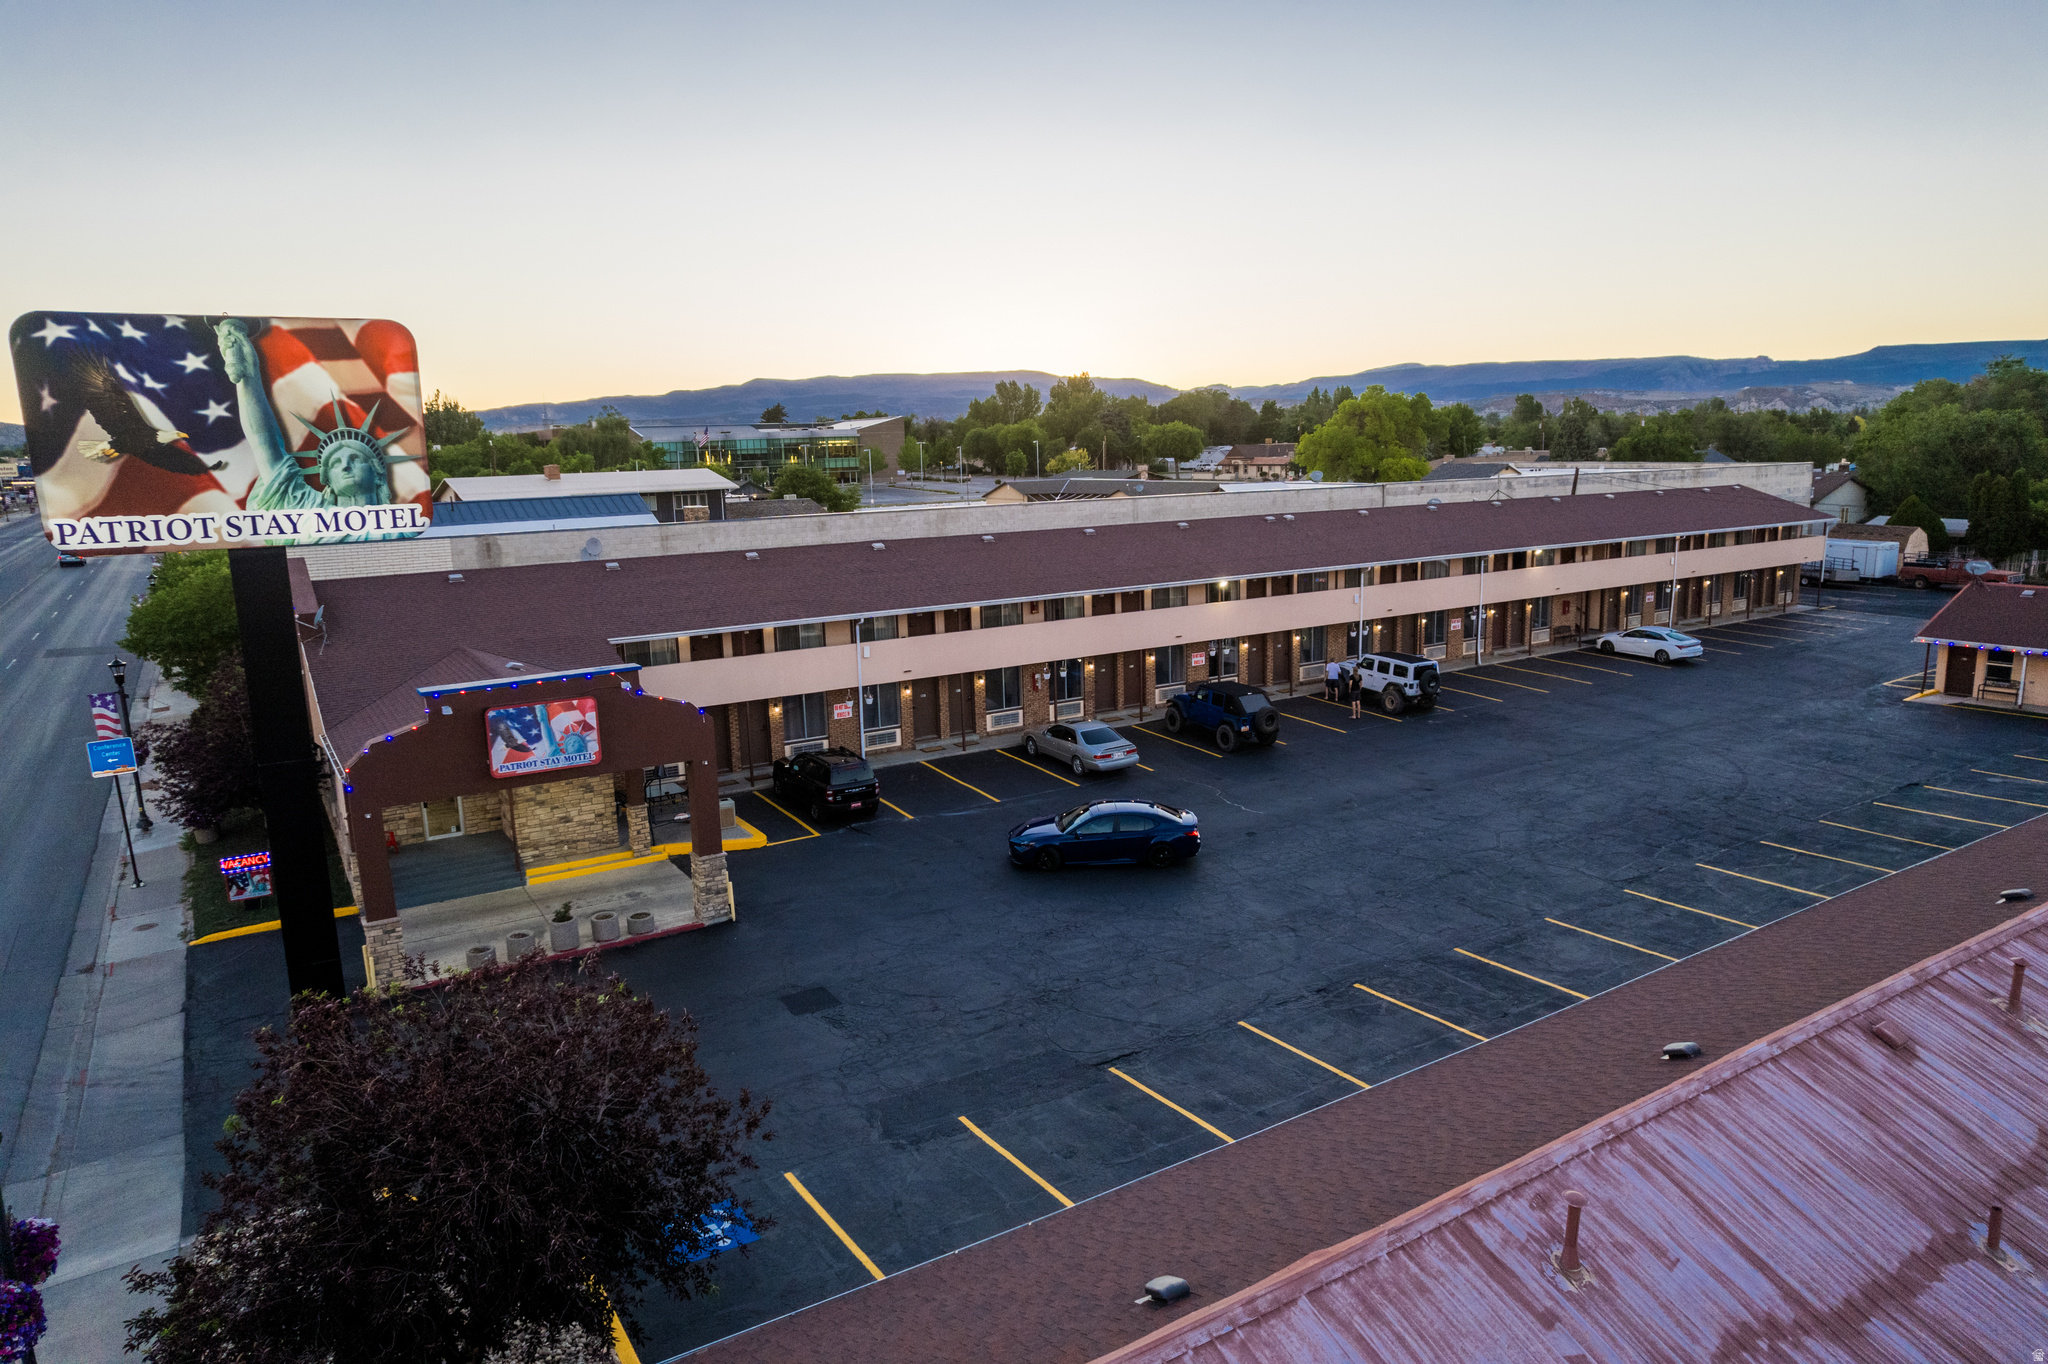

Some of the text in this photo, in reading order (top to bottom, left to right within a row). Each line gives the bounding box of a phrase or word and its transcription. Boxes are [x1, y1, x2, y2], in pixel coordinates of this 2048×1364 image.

[54, 506, 426, 546] PATRIOT STAY MOTEL
[93, 743, 126, 751] Conference
[499, 753, 594, 771] PATRIOT STAY MOTEL
[222, 854, 268, 869] VACANCY
